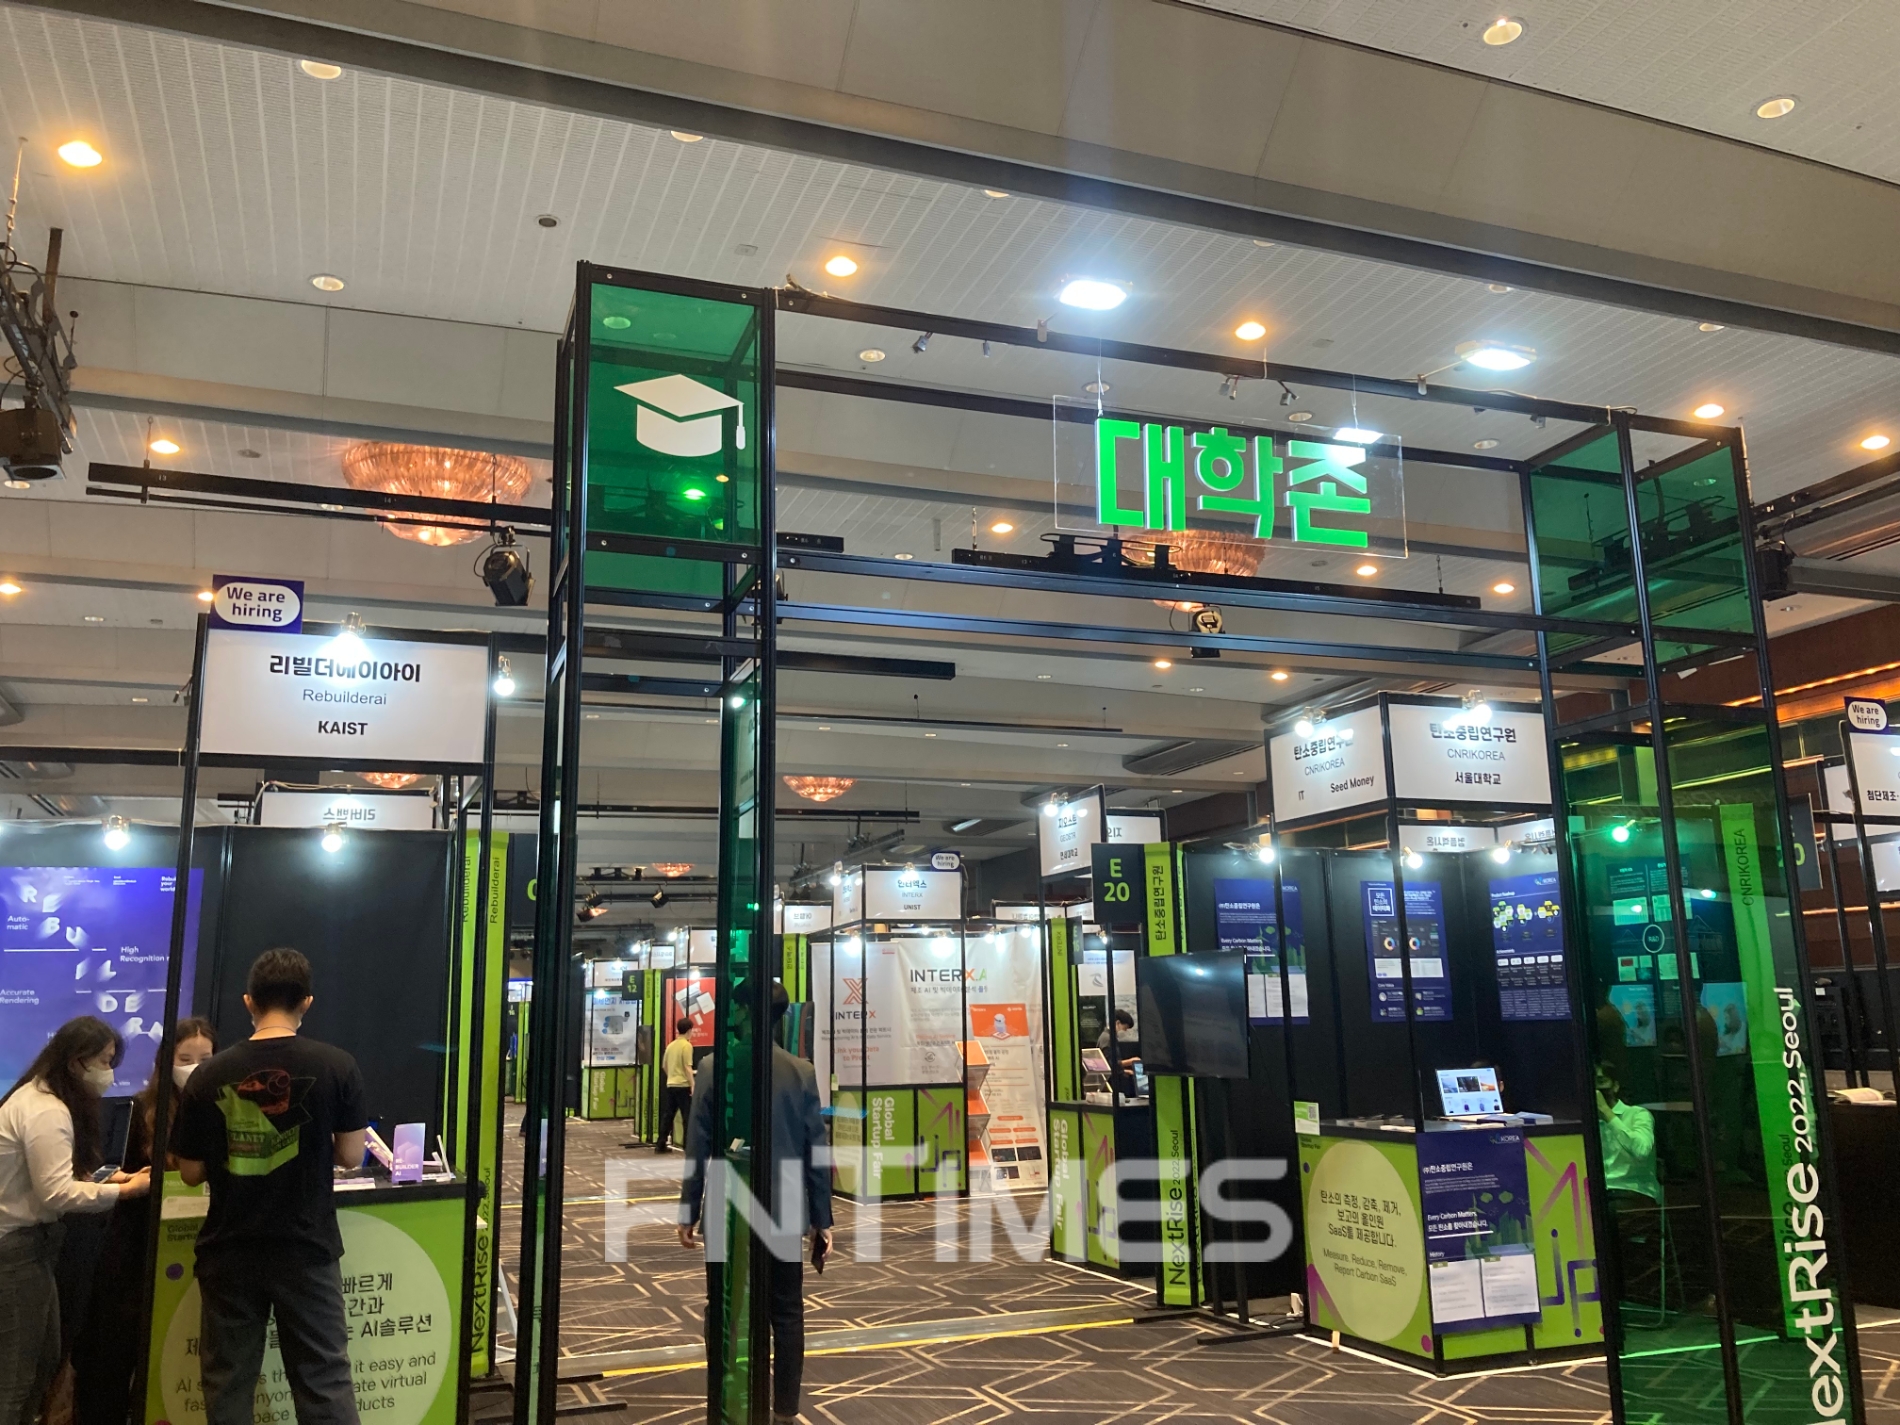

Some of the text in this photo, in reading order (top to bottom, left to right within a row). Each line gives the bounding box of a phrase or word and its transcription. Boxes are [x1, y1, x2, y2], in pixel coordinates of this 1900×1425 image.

[1096, 418, 1370, 548] 대학존
[227, 587, 286, 603] We are
[232, 603, 283, 622] hiring
[302, 689, 387, 705] Rebuilderai
[1852, 704, 1879, 715] We are
[318, 720, 368, 735] KAIST
[1856, 715, 1880, 728] hiring
[1430, 723, 1517, 742] 탄소중립연구원
[1447, 748, 1506, 761] CNRIKOREA
[1304, 757, 1345, 776] CNRIKOREA
[1331, 780, 1349, 793] Seed
[1350, 775, 1374, 791] Money
[1455, 772, 1502, 785] 서울대학교
[937, 860, 954, 868] hiring
[1110, 859, 1122, 877] E
[1733, 828, 1754, 907] CNRIKOREA
[490, 857, 500, 924] Rebuilderai
[1104, 882, 1130, 901] 20
[1153, 866, 1166, 940] 탄소중립연구원
[120, 955, 164, 963] Recognition
[121, 946, 139, 954] High
[627, 984, 637, 993] 12
[629, 975, 635, 983] E
[885, 1096, 895, 1140] Global
[872, 1097, 883, 1180] Startup Fair
[1061, 1119, 1069, 1179] Global
[1055, 1193, 1063, 1230] Fair
[1320, 1190, 1341, 1206] 탄소의
[1383, 1200, 1402, 1217] 제거,
[1337, 1209, 1385, 1230] 보고의 올인원
[1428, 1213, 1439, 1222] Every
[1440, 1212, 1457, 1220] Carbon
[1167, 1187, 1186, 1286] NextRise
[1328, 1223, 1397, 1248] SaaS를 제공합니다.
[1428, 1225, 1437, 1233] 모든
[1351, 1254, 1377, 1269] Reduce,
[1378, 1260, 1407, 1276] Remove,
[1334, 1263, 1397, 1287] Report Carbon SaaS
[472, 1234, 489, 1353] NextRise
[1784, 1162, 1847, 1425] extRise
[345, 1297, 384, 1316] 간과
[360, 1314, 433, 1339] AI솔루션
[355, 1352, 436, 1377] it easy and
[176, 1379, 192, 1394] AI
[381, 1372, 427, 1390] virtual
[253, 1407, 289, 1425] pace
[356, 1398, 395, 1413] ducts
